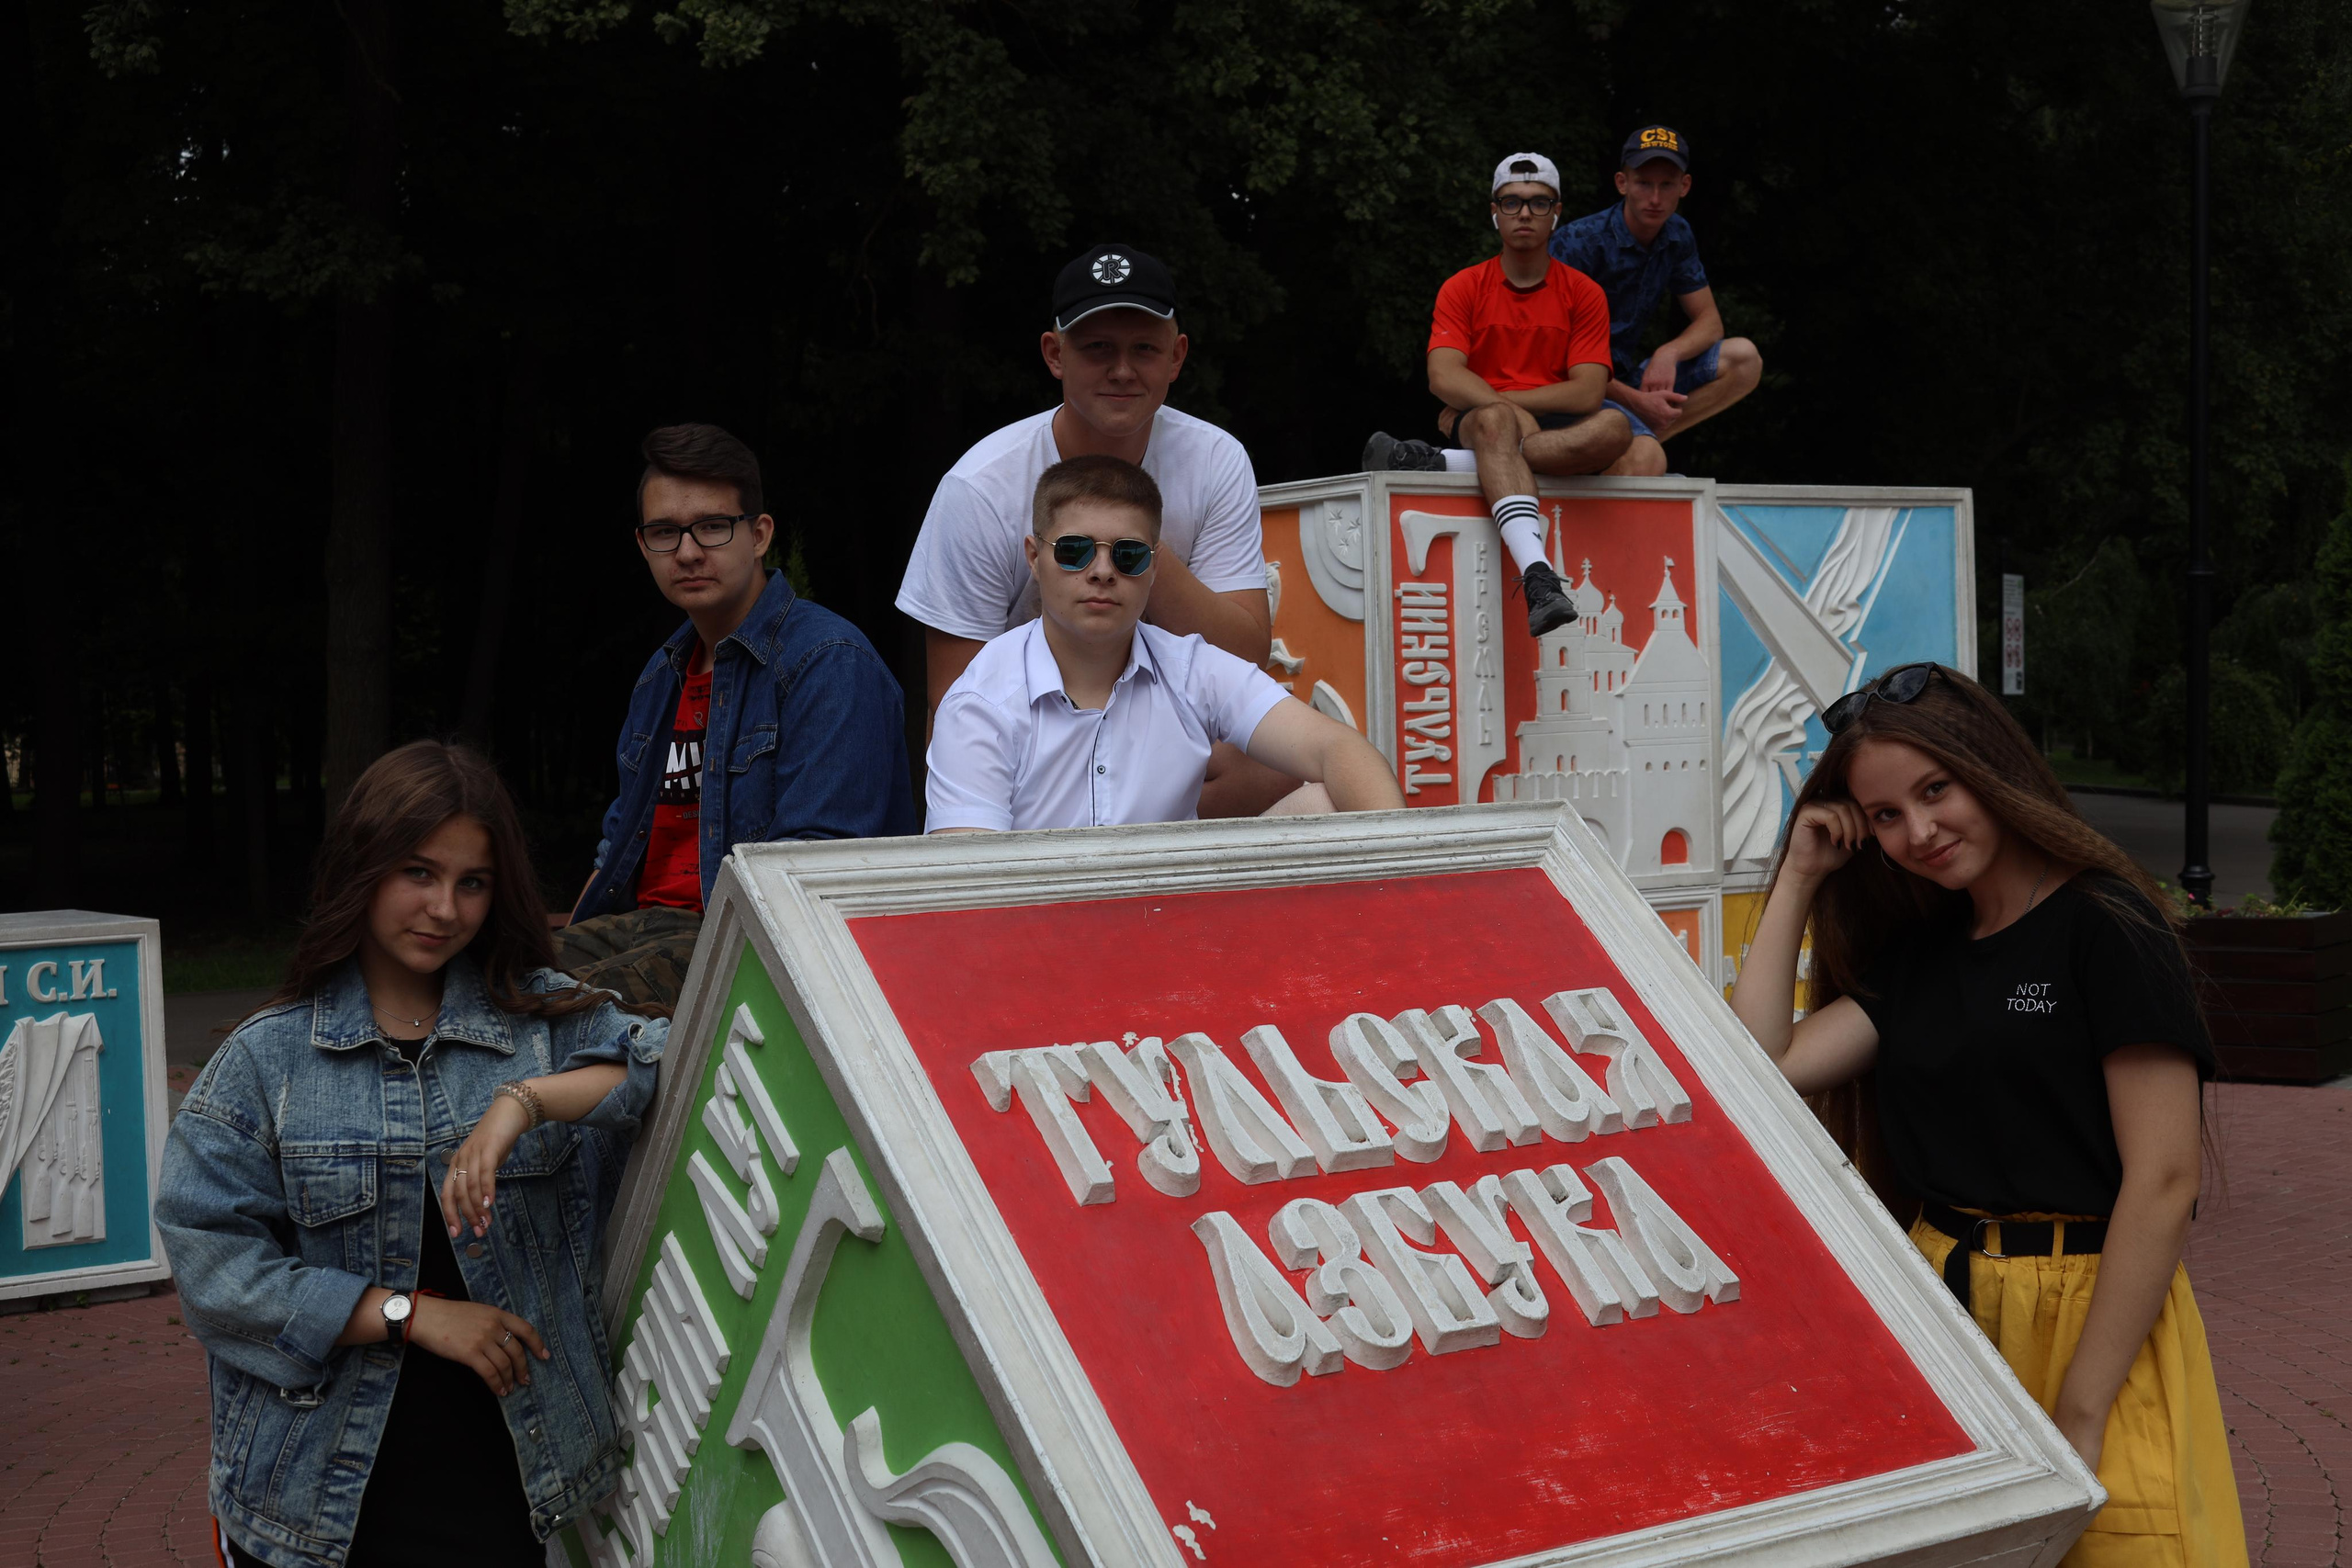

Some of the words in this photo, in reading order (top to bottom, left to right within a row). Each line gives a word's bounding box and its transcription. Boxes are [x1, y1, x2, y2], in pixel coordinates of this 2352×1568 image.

[1640, 128, 1678, 144] CSI
[1394, 581, 1452, 795] ТУЛЬСКИЙ
[27, 958, 118, 1003] С.И.
[2016, 983, 2052, 997] NOT
[2007, 998, 2057, 1013] TODAY
[969, 987, 1692, 1206] ТУЛЬСКАЯ
[1190, 1156, 1740, 1387] АЗБУКА
